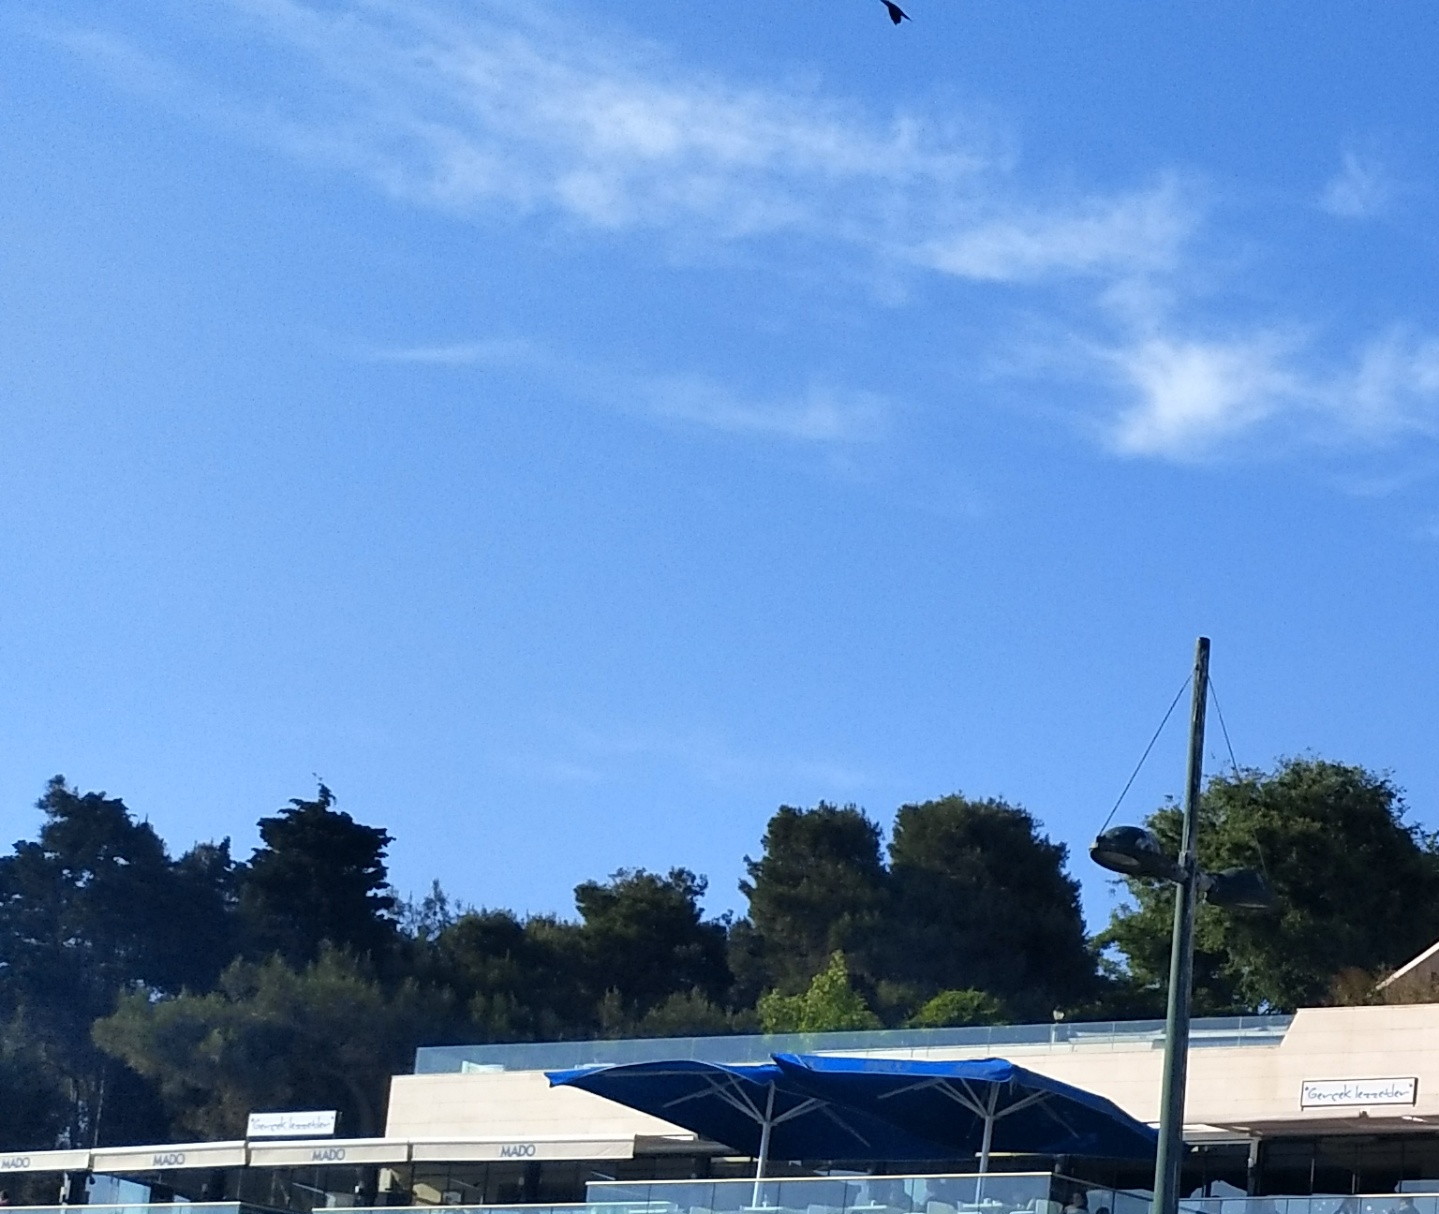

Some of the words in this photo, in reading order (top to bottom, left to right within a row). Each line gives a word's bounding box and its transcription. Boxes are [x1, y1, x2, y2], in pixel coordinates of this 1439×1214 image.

[312, 1149, 346, 1162] MADO
[500, 1144, 537, 1158] MADO
[1, 1156, 31, 1170] MADO
[153, 1153, 186, 1166] MADO
